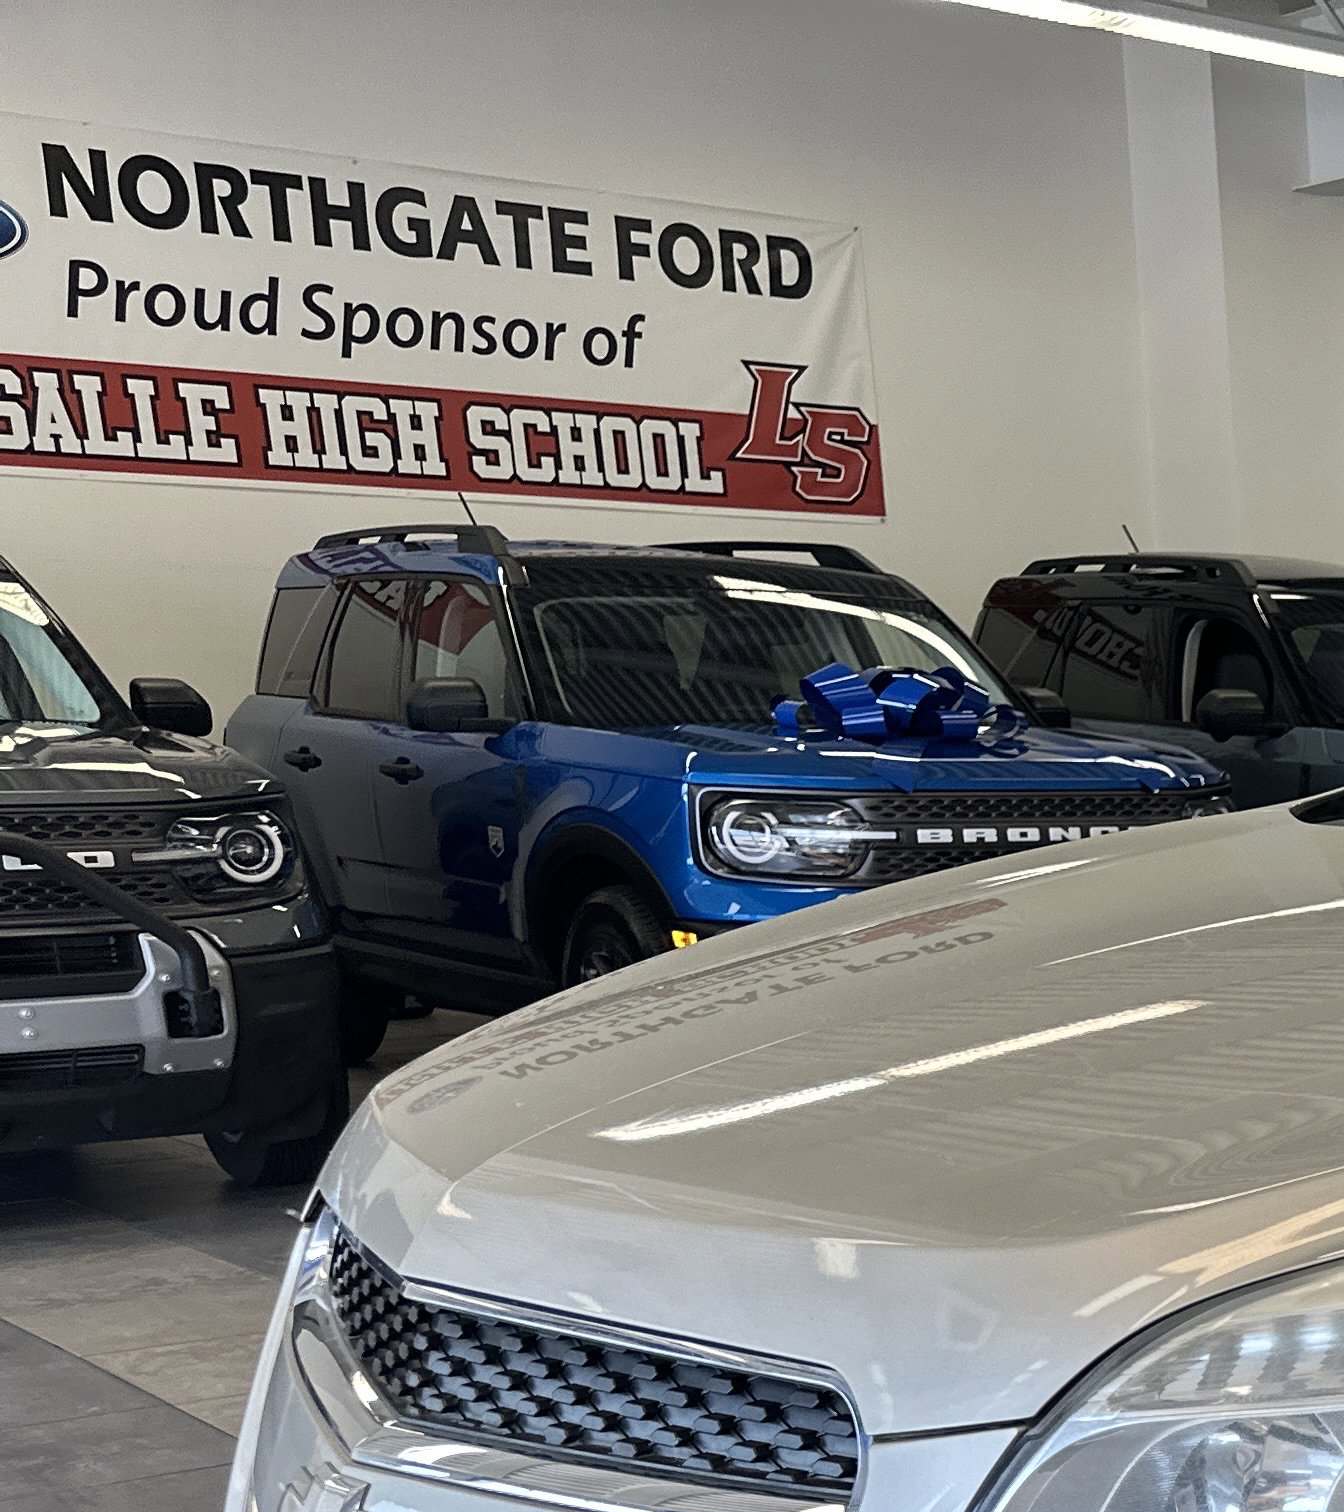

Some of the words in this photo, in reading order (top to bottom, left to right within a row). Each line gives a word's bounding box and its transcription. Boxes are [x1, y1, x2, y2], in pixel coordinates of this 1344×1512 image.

[41, 142, 593, 277] NORTHGATE
[614, 215, 813, 300] FORD
[66, 259, 280, 336] Proud
[301, 282, 566, 360] Sponsor
[583, 313, 646, 369] of
[254, 385, 450, 480] HIGH
[466, 402, 727, 497] SCHOOL
[728, 360, 872, 506] LS
